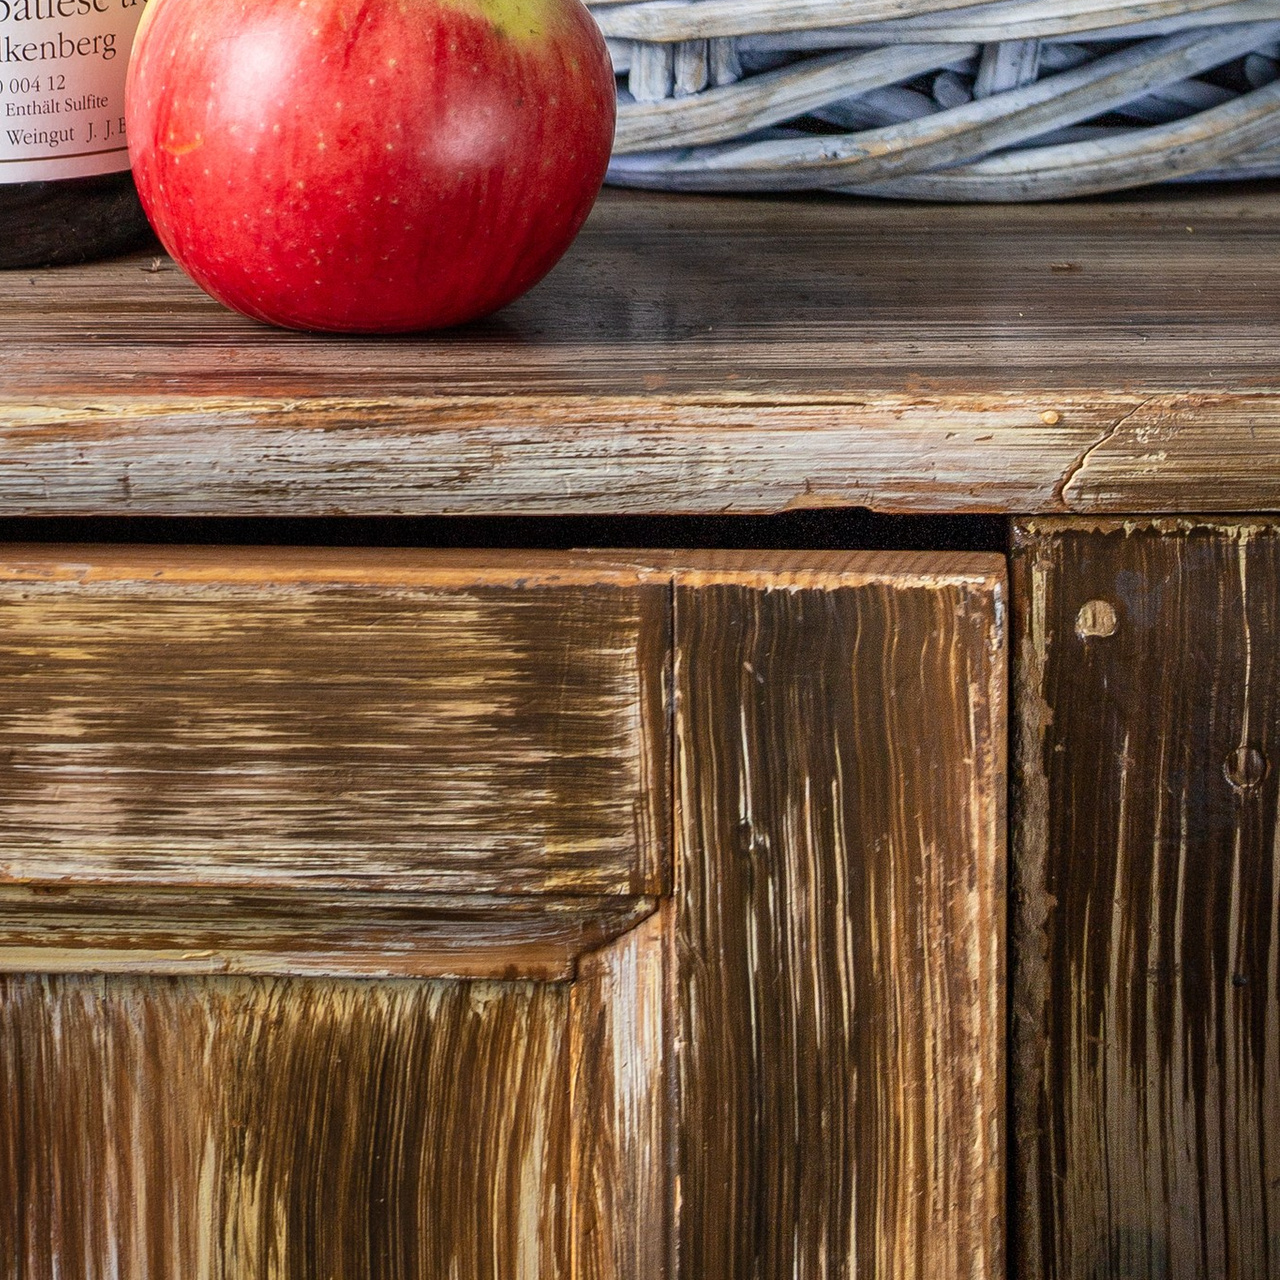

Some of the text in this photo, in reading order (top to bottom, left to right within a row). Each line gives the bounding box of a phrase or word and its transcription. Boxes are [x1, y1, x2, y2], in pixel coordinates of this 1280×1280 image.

[9, 75, 41, 95] 004
[47, 74, 66, 92] 12
[5, 99, 62, 117] Enthält
[64, 93, 109, 113] Sulfite
[6, 126, 76, 148] Weingut
[85, 122, 97, 143] J.
[103, 119, 115, 141] J.
